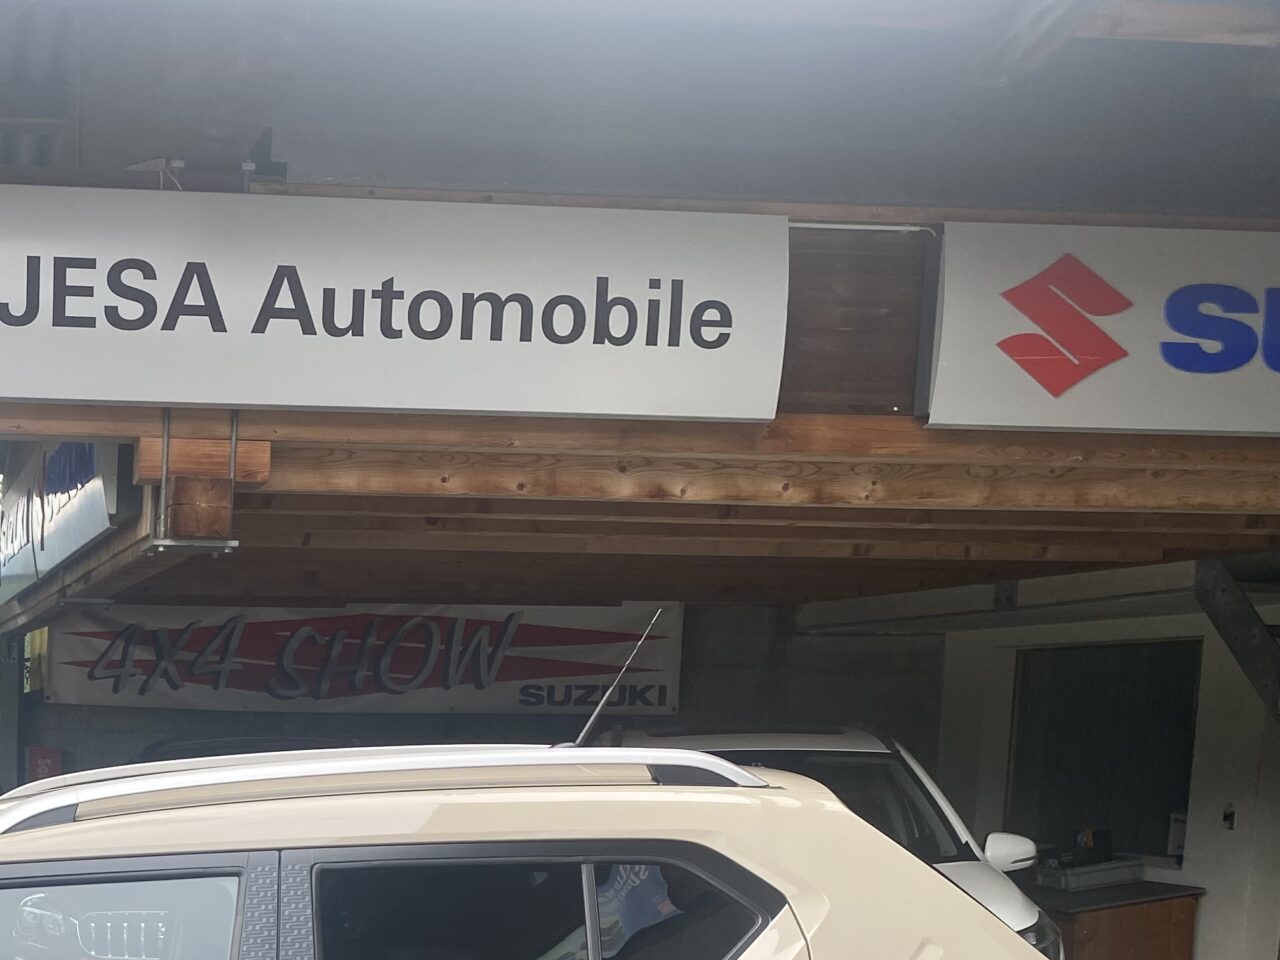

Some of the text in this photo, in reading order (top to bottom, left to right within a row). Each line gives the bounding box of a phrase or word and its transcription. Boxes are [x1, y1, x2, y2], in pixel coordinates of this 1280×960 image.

[250, 263, 735, 351] Automobile
[267, 610, 524, 701] SHOW
[518, 684, 669, 708] SUZUKI
